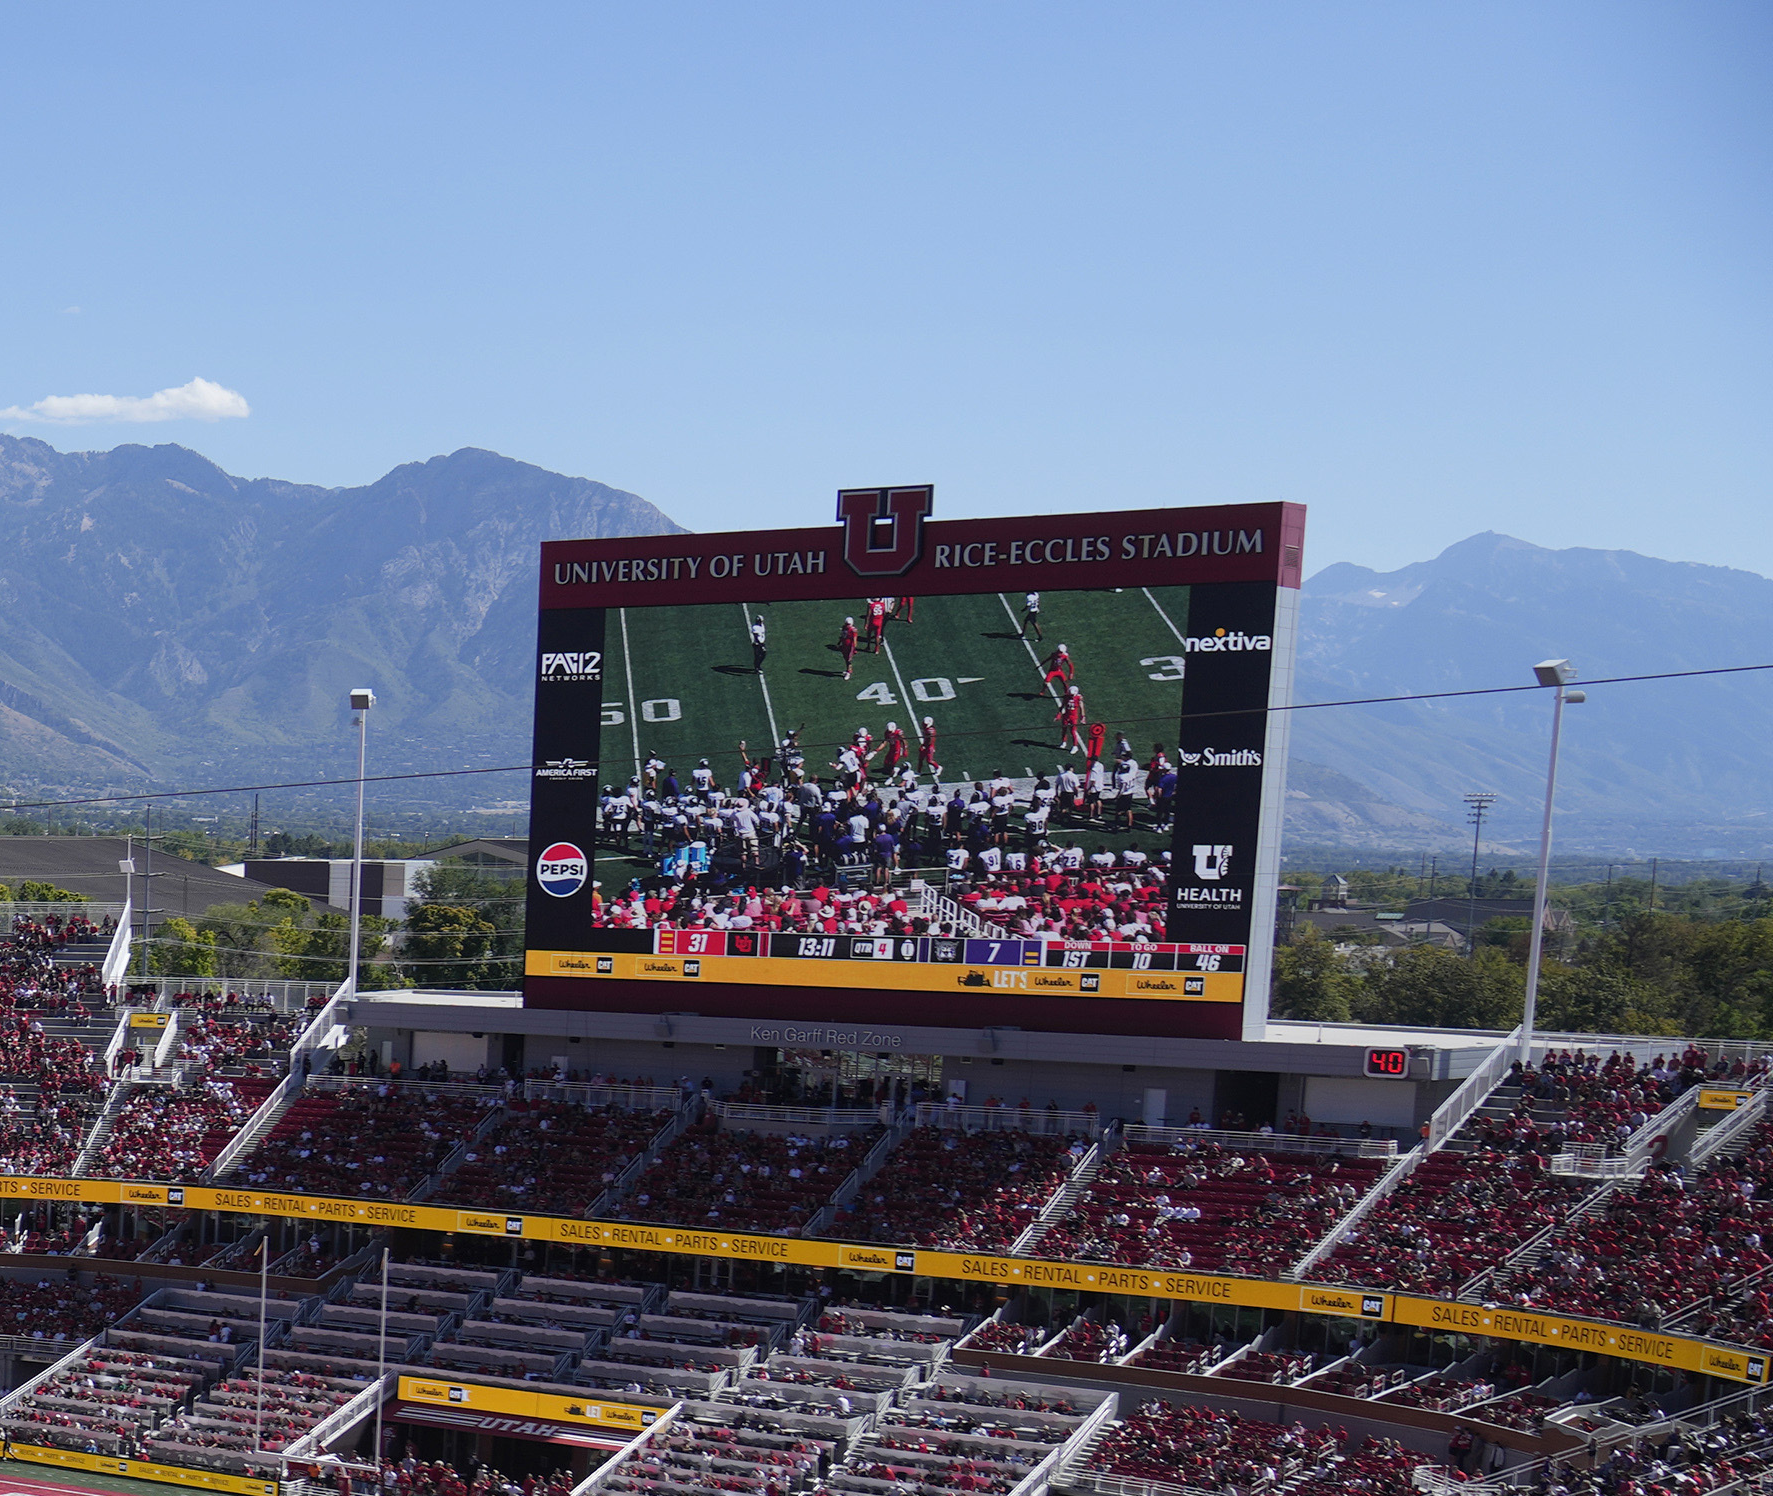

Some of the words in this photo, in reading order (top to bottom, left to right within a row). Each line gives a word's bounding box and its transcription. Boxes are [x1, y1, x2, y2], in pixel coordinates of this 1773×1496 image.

[934, 535, 1111, 568] RICE-ECCLES
[1121, 528, 1263, 559] STADIUM
[554, 557, 703, 585] UNIVERSITY
[709, 554, 744, 578] OF
[754, 550, 826, 577] UTAH
[1185, 632, 1272, 652] nextiva
[541, 674, 601, 682] NETWORKS
[856, 677, 956, 705] 40
[1203, 747, 1262, 766] Smith's
[536, 768, 573, 777] AMERICA
[573, 768, 598, 777] FIRST
[540, 864, 584, 876] PEPSI
[1177, 887, 1242, 902] HEALTH
[688, 933, 709, 953] 31
[798, 937, 836, 957] 13:11
[854, 940, 873, 954] QTR
[877, 942, 887, 955] 4
[1064, 942, 1092, 950] DOWN
[1190, 945, 1213, 953] BALL
[988, 943, 1001, 963] 7
[1062, 951, 1092, 968] 1ST
[1132, 953, 1153, 969] 10
[559, 959, 592, 969] Wheeler
[598, 960, 612, 971] CAT
[644, 963, 677, 972] Wheeler
[684, 963, 699, 974] CAT
[1196, 954, 1221, 971] 46
[1034, 974, 1074, 987] Wheeler
[1081, 977, 1099, 988] CAT
[1136, 980, 1177, 991] Wheeler
[1185, 979, 1204, 992] CAT
[751, 1026, 780, 1042] Ken
[784, 1027, 823, 1045] Garff
[826, 1029, 857, 1045] Red
[862, 1031, 902, 1047] Zone
[1371, 1052, 1403, 1073] 40
[29, 1181, 81, 1197] SERVICE
[129, 1189, 163, 1201] Wheeler
[168, 1190, 184, 1201] CAT
[214, 1193, 251, 1208] SALES
[262, 1196, 307, 1212] RENTAL
[318, 1201, 355, 1217] PARTS
[366, 1206, 416, 1224] SERVICE
[466, 1218, 500, 1229] Wheeler
[506, 1220, 522, 1232] CAT
[560, 1223, 601, 1239] SALES
[612, 1227, 662, 1245] RENTAL
[675, 1233, 718, 1250] PARTS
[731, 1237, 788, 1257] SERVICE
[848, 1252, 887, 1265] Wheeler
[896, 1255, 914, 1267] CAT
[962, 1259, 1008, 1277] SALES
[1023, 1265, 1082, 1284] RENTAL
[1098, 1272, 1149, 1290] PARTS
[1165, 1277, 1231, 1298] SERVICE
[1311, 1295, 1354, 1309] Wheeler
[1363, 1300, 1382, 1313] CAT
[1432, 1306, 1479, 1326] SALES
[1494, 1316, 1547, 1337] RENTAL
[1561, 1324, 1606, 1347] PARTS
[1618, 1334, 1673, 1359] SERVICE
[1709, 1354, 1742, 1372] Wheeler
[1747, 1362, 1764, 1376] CAT
[478, 1416, 555, 1437] UTAH
